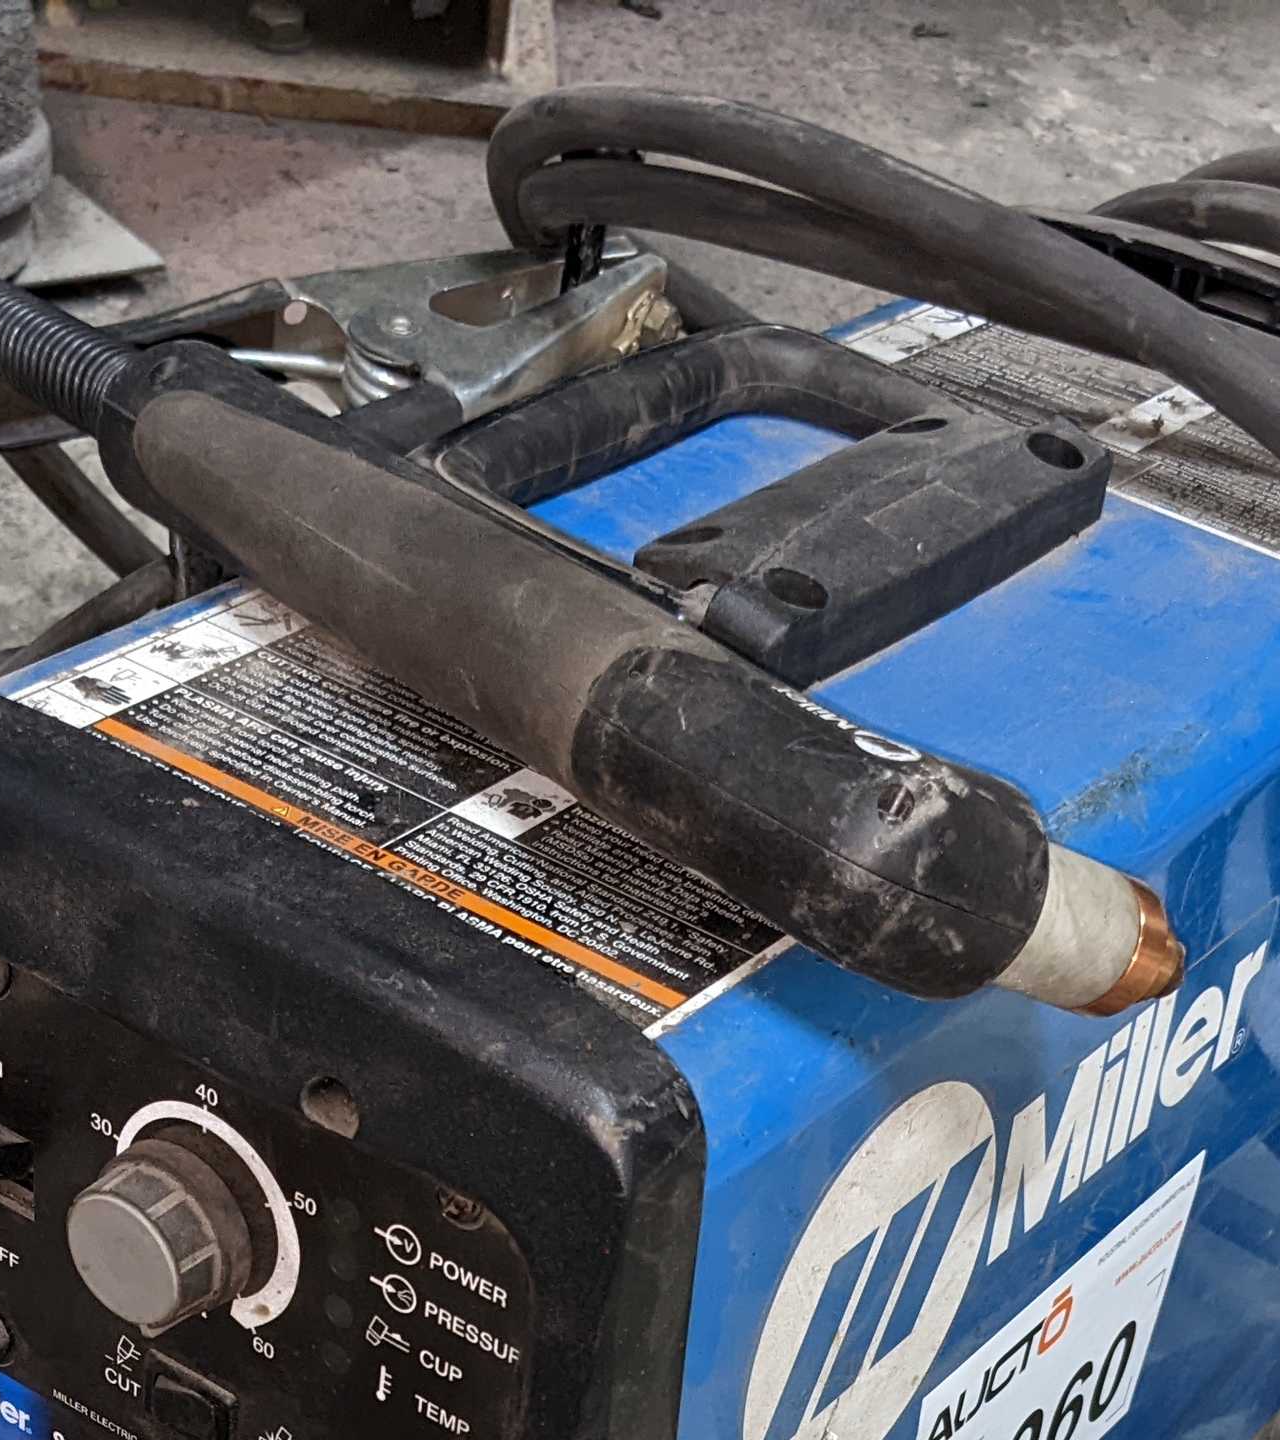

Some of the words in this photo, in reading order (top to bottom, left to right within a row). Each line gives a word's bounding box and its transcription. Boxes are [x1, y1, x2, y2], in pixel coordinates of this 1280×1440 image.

[254, 650, 324, 682] CUTTING
[318, 680, 349, 695] can
[345, 692, 395, 716] cause
[390, 713, 422, 729] fire
[417, 726, 439, 737] or
[434, 734, 516, 773] explosion.
[279, 715, 320, 735] closed
[282, 685, 340, 712] protection
[336, 711, 367, 725] from
[302, 705, 335, 721] keep
[330, 718, 403, 753] extinguisher
[157, 703, 180, 714] Do
[218, 732, 267, 756] material
[262, 753, 293, 768] near
[288, 766, 333, 788] cutting
[329, 786, 364, 803] path.
[172, 687, 242, 720] PLASMA
[266, 732, 302, 749] can
[295, 745, 347, 771] cause
[340, 767, 393, 793] injury.
[228, 726, 259, 741] from
[254, 739, 289, 755] torch
[311, 719, 341, 734] over
[336, 731, 408, 766] combustible
[404, 764, 461, 791] surfaces.
[133, 713, 162, 727] Use
[206, 748, 262, 776] specified
[270, 779, 324, 806] Owner's
[318, 803, 369, 828] Manual.
[222, 745, 264, 765] before
[259, 763, 345, 805] disassembling
[340, 803, 379, 822] torch.
[295, 815, 355, 845] MISE
[351, 842, 388, 861] EN
[384, 859, 467, 900] GARDE
[445, 816, 482, 834] Read
[477, 832, 538, 861] American
[534, 859, 588, 886] National
[585, 883, 644, 913] Standard
[569, 817, 605, 835] Keep
[601, 832, 633, 849] your
[629, 846, 665, 864] head
[592, 860, 620, 875] and
[423, 828, 484, 858] American
[479, 855, 533, 882] Welding
[577, 902, 606, 917] 550
[578, 844, 633, 870] Material
[630, 868, 672, 889] Safety
[669, 886, 701, 903] Data
[617, 883, 676, 912] materials
[680, 881, 742, 911] breathing
[391, 845, 443, 871] Printing
[553, 924, 579, 938] DC
[575, 935, 622, 959] 20402.
[484, 879, 517, 896] CFR
[547, 910, 581, 927] from
[608, 939, 690, 981] Government
[512, 882, 554, 903] OSHA
[551, 901, 595, 923] Safety
[590, 920, 620, 935] and
[616, 932, 662, 955] Health
[548, 877, 577, 892] and
[573, 889, 613, 909] Allied
[678, 939, 713, 958] from
[501, 935, 543, 957] peut
[572, 970, 666, 1018] hasardeux.
[195, 1083, 218, 1106] 40
[987, 940, 1267, 1266] Miller
[91, 1113, 112, 1137] 30
[294, 1192, 317, 1216] 50
[429, 1252, 508, 1308] POWER
[253, 1337, 275, 1359] 60
[420, 1350, 463, 1382] CUP
[53, 1388, 89, 1417] MILLER
[105, 1367, 141, 1399] CUT
[414, 1394, 470, 1435] TEMP
